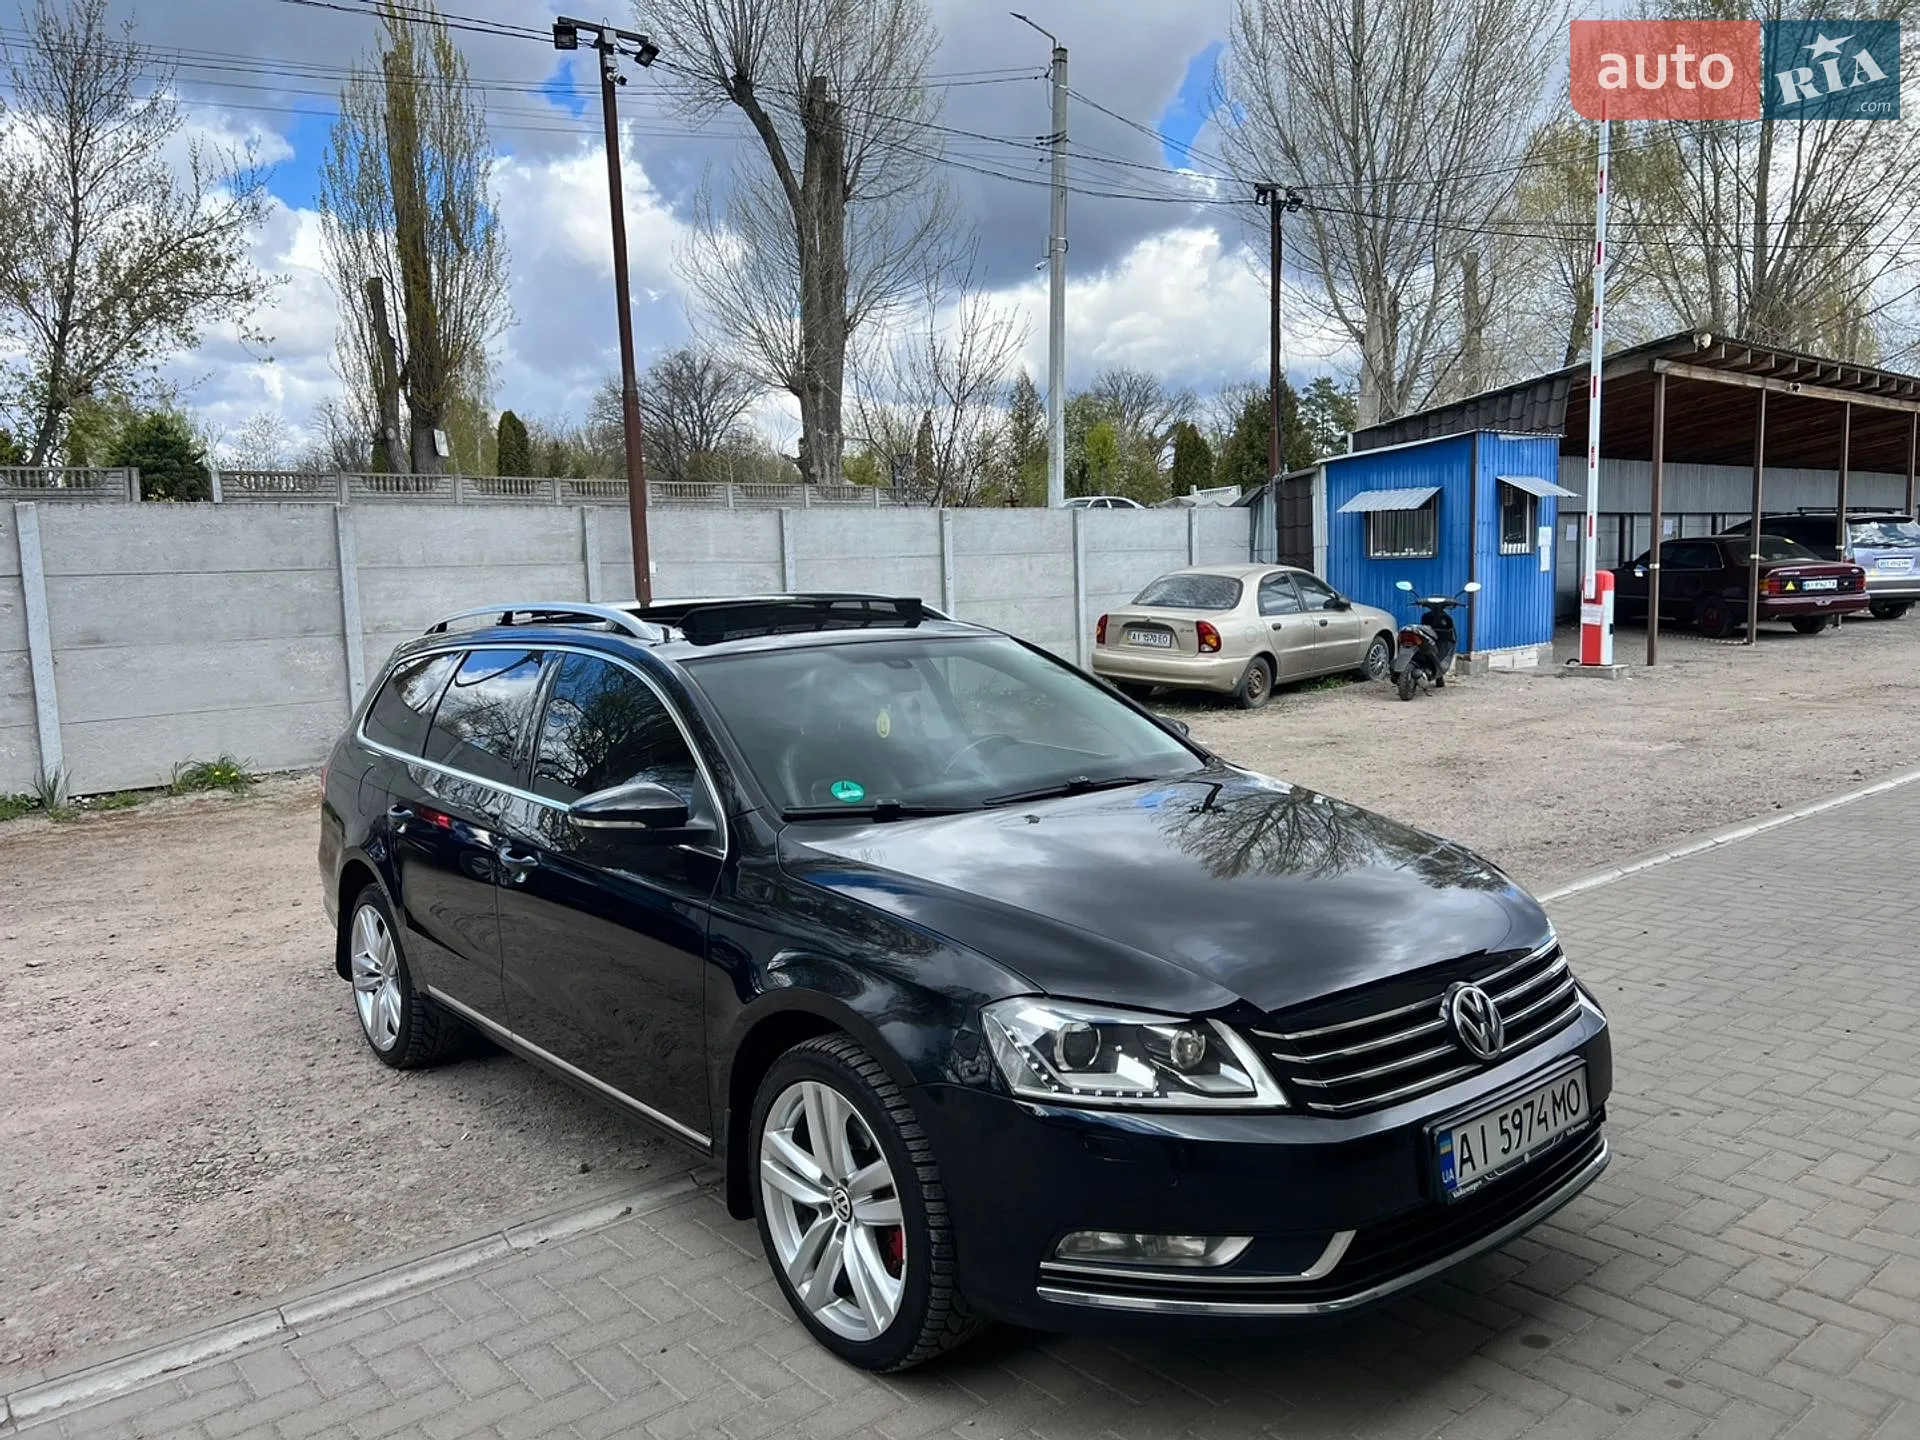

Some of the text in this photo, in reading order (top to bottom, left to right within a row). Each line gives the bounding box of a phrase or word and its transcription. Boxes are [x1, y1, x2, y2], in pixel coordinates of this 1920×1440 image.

[1458, 1079, 1581, 1178] AI 5974 MO
[1442, 1167, 1456, 1184] UA
